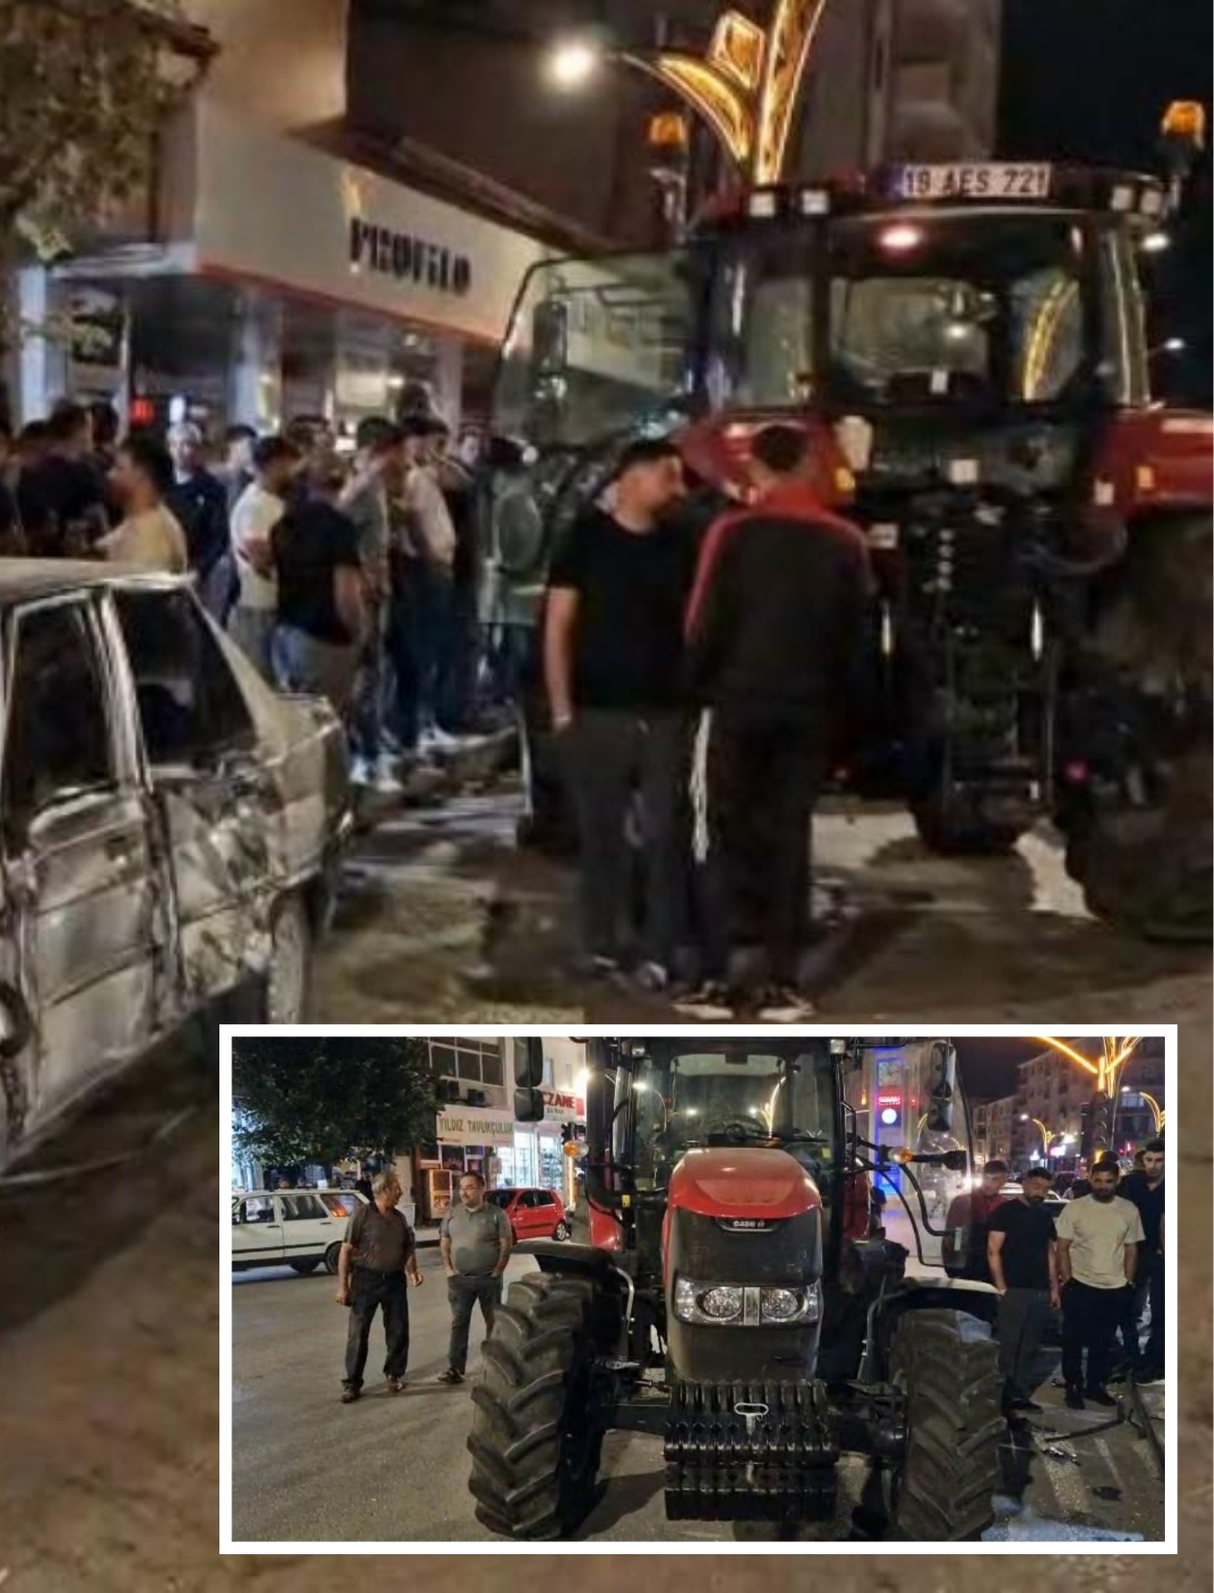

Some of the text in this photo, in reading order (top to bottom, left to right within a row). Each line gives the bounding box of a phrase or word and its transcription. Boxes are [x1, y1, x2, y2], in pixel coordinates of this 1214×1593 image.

[906, 167, 1047, 193] 19 AES 721
[438, 1117, 464, 1132] YILDIZ
